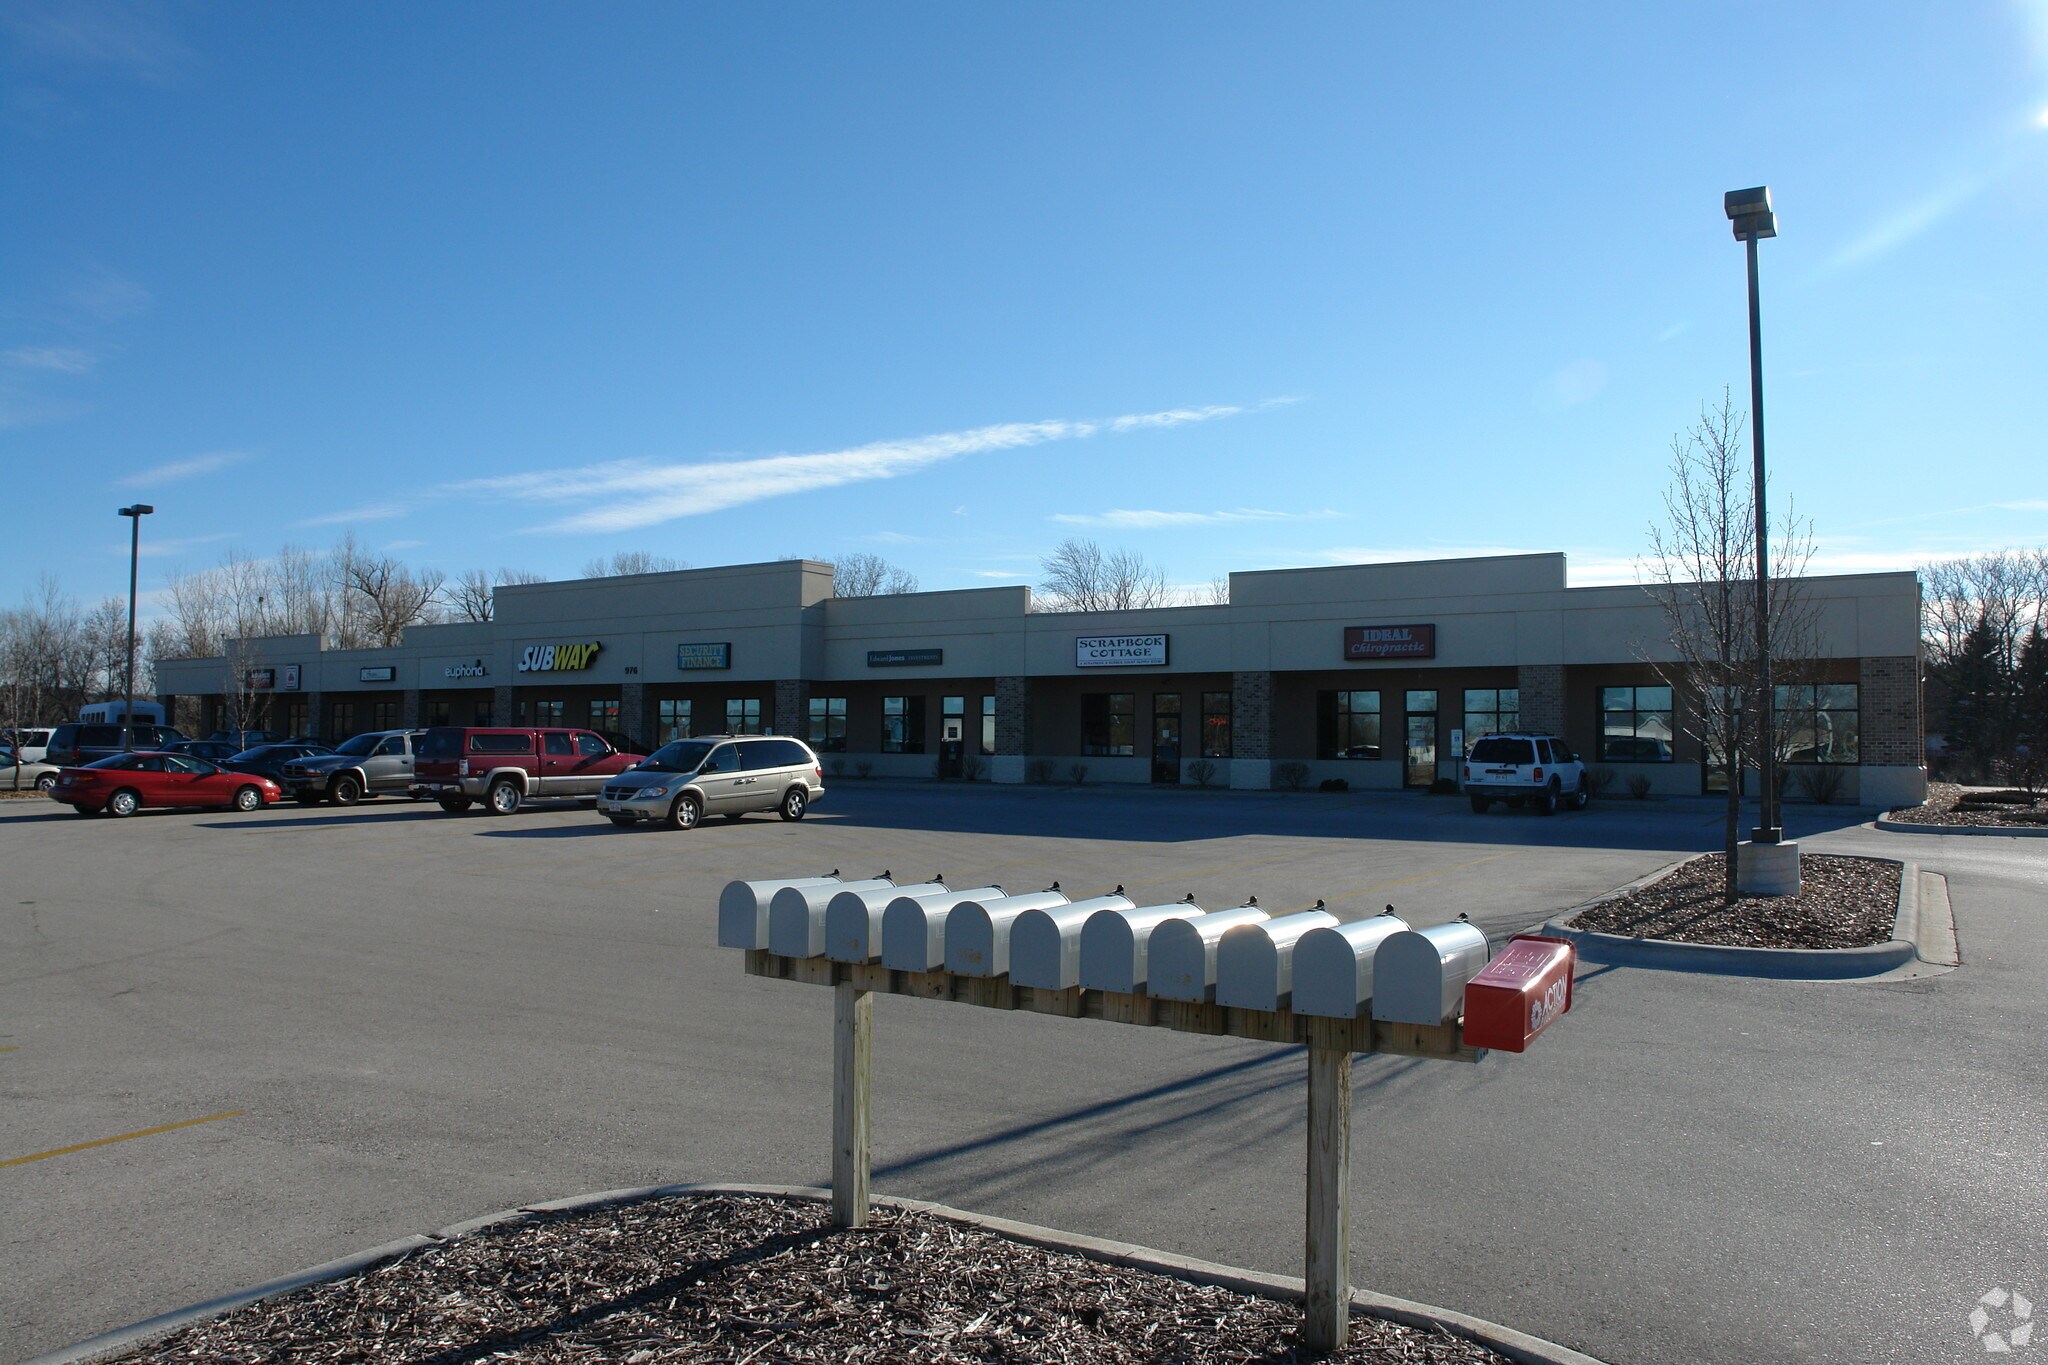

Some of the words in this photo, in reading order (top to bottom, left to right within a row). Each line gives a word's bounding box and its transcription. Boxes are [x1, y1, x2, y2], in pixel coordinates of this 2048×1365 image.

[1363, 628, 1412, 642] IDEAL
[1079, 637, 1163, 648] SCRAPBOOK
[679, 644, 725, 656] SECURITY
[1090, 648, 1152, 658] COTTAGE
[1351, 642, 1425, 656] Chiropractic
[517, 641, 601, 672] SUBWAY
[681, 656, 723, 668] FINANCE
[888, 654, 905, 662] Jones
[625, 666, 638, 674] 976
[1542, 974, 1568, 1016] ACTION
